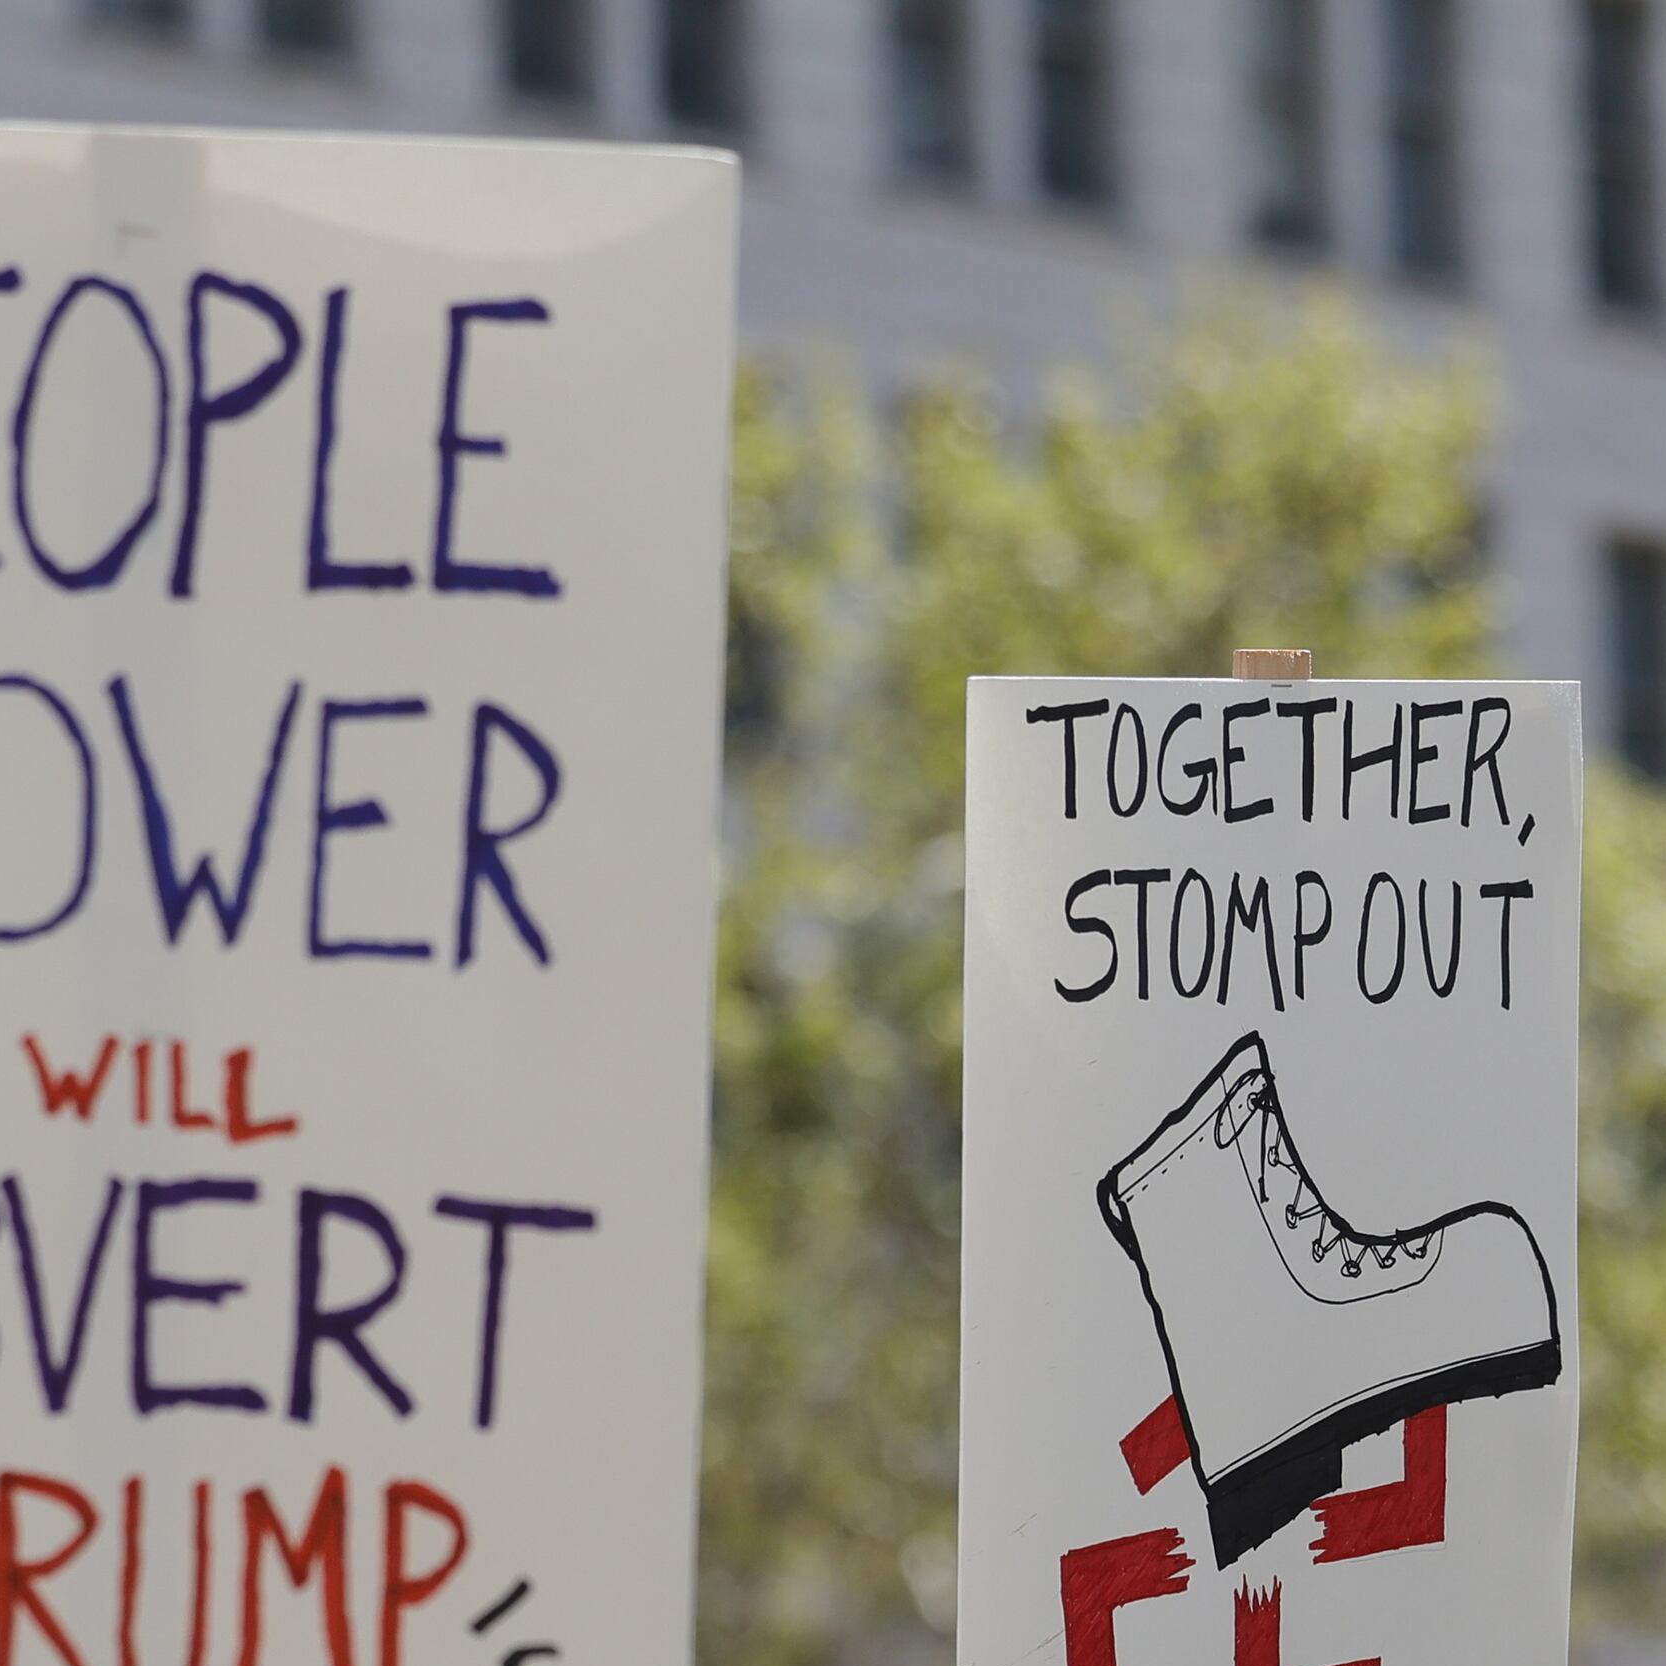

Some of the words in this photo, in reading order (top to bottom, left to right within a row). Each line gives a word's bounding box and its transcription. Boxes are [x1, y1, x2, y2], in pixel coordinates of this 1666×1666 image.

[1026, 697, 1535, 846] TOGETHER,
[1054, 867, 1332, 1012] STOMP
[1357, 871, 1534, 1010] OUT
[23, 1034, 298, 1144] WILL
